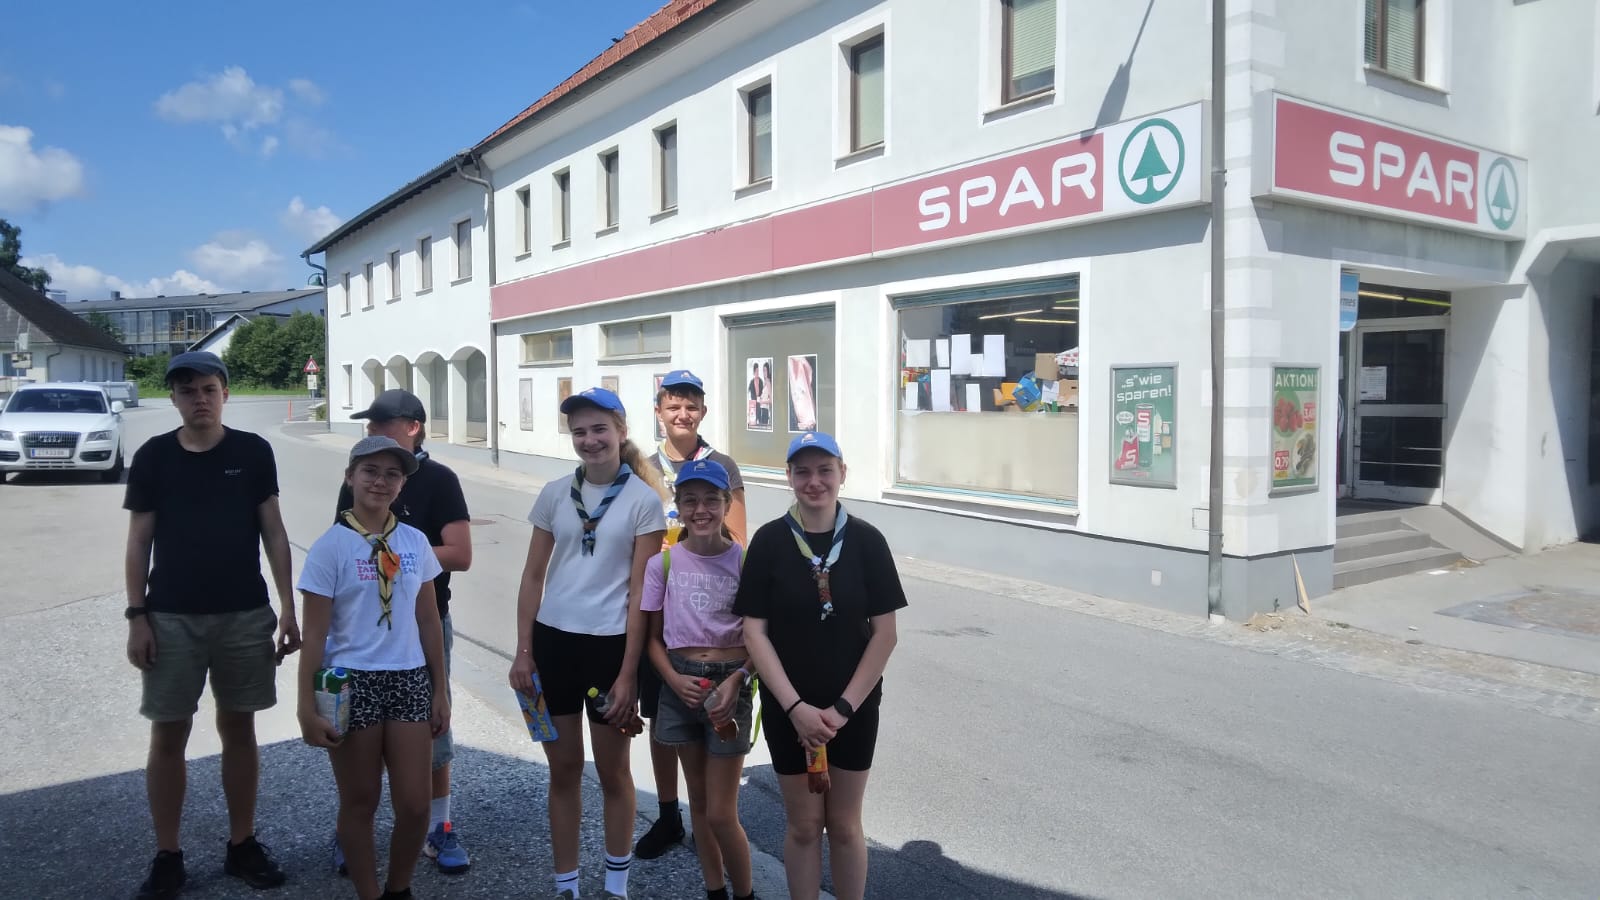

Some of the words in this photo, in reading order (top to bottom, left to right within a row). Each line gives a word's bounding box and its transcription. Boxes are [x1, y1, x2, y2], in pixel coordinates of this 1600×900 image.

[1328, 130, 1475, 210] SPAR
[919, 150, 1097, 232] SPAR
[1139, 373, 1163, 386] wie
[1274, 374, 1317, 388] AKTION!
[1116, 384, 1172, 404] sparen!
[669, 571, 740, 593] ACTIVE
